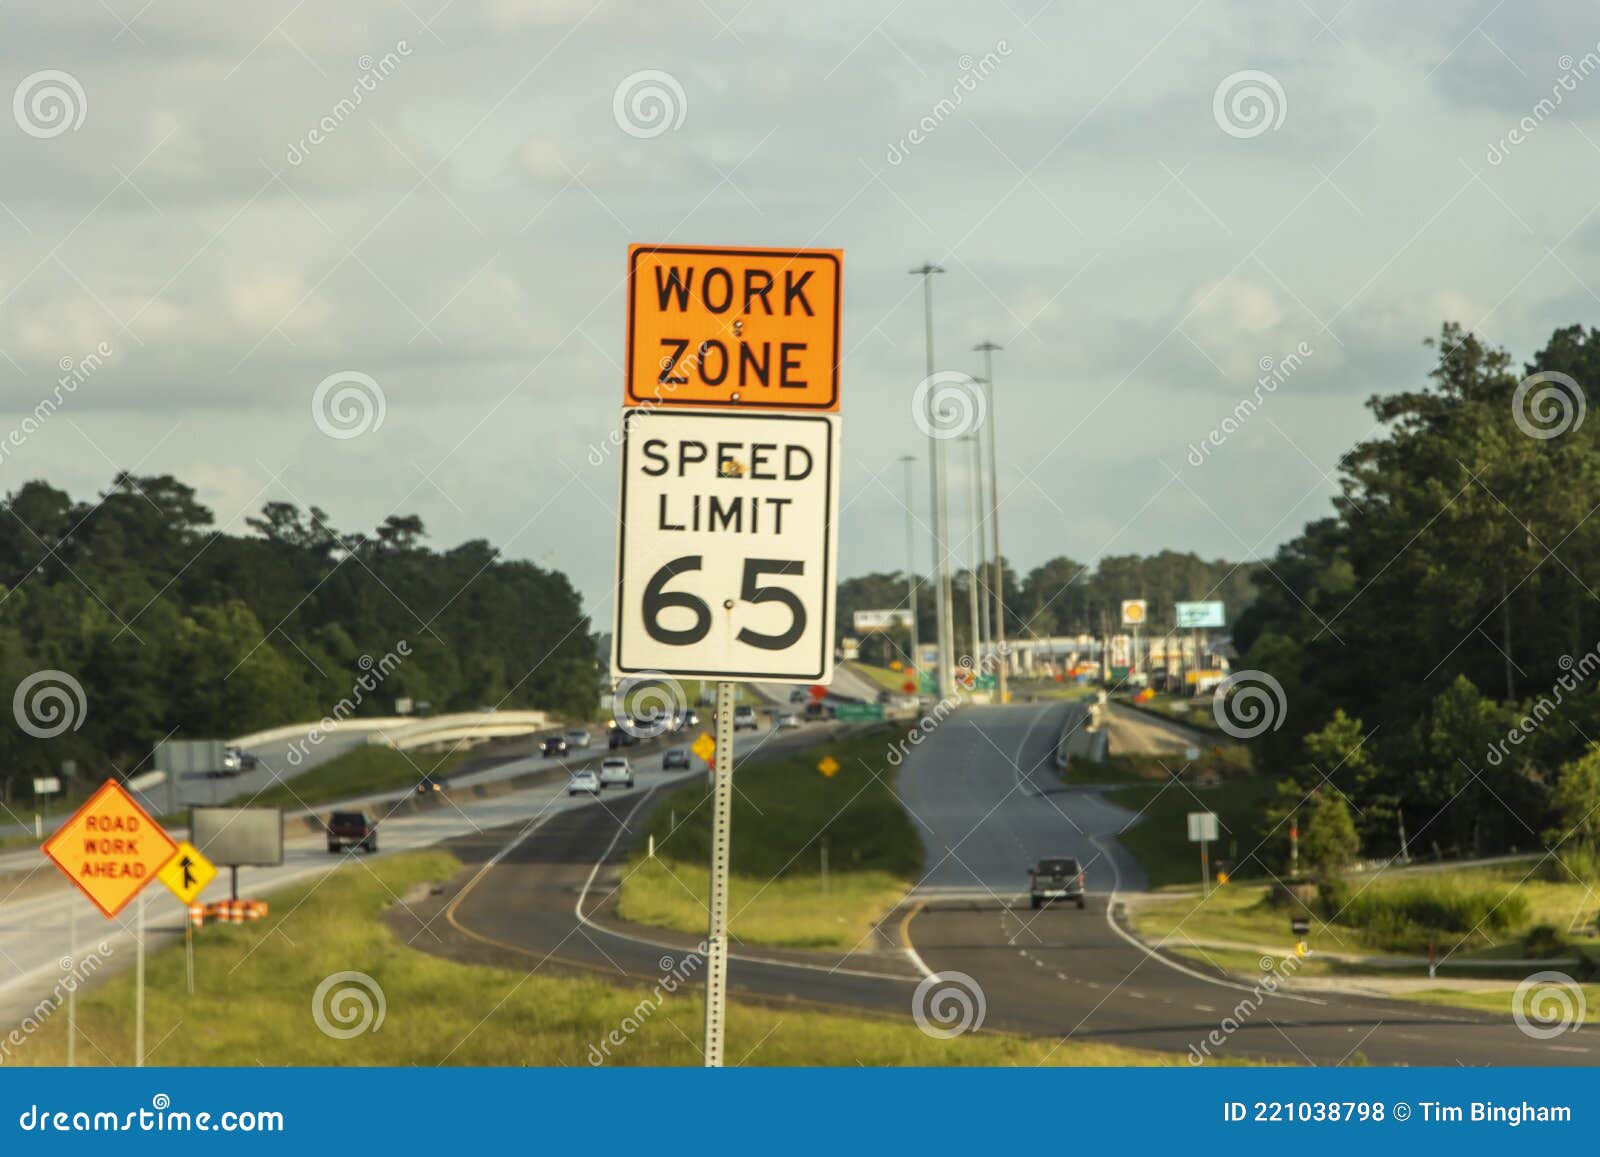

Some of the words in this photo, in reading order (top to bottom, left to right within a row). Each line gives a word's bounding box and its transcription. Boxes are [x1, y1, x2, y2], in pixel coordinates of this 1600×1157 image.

[654, 265, 815, 317] WORK
[657, 338, 808, 389] ZONE
[641, 439, 814, 481] SPEED
[658, 494, 792, 535] LIMIT
[642, 555, 808, 651] 65
[85, 815, 140, 833] ROAD
[83, 838, 139, 855] WORK
[80, 862, 147, 879] AHEAD
